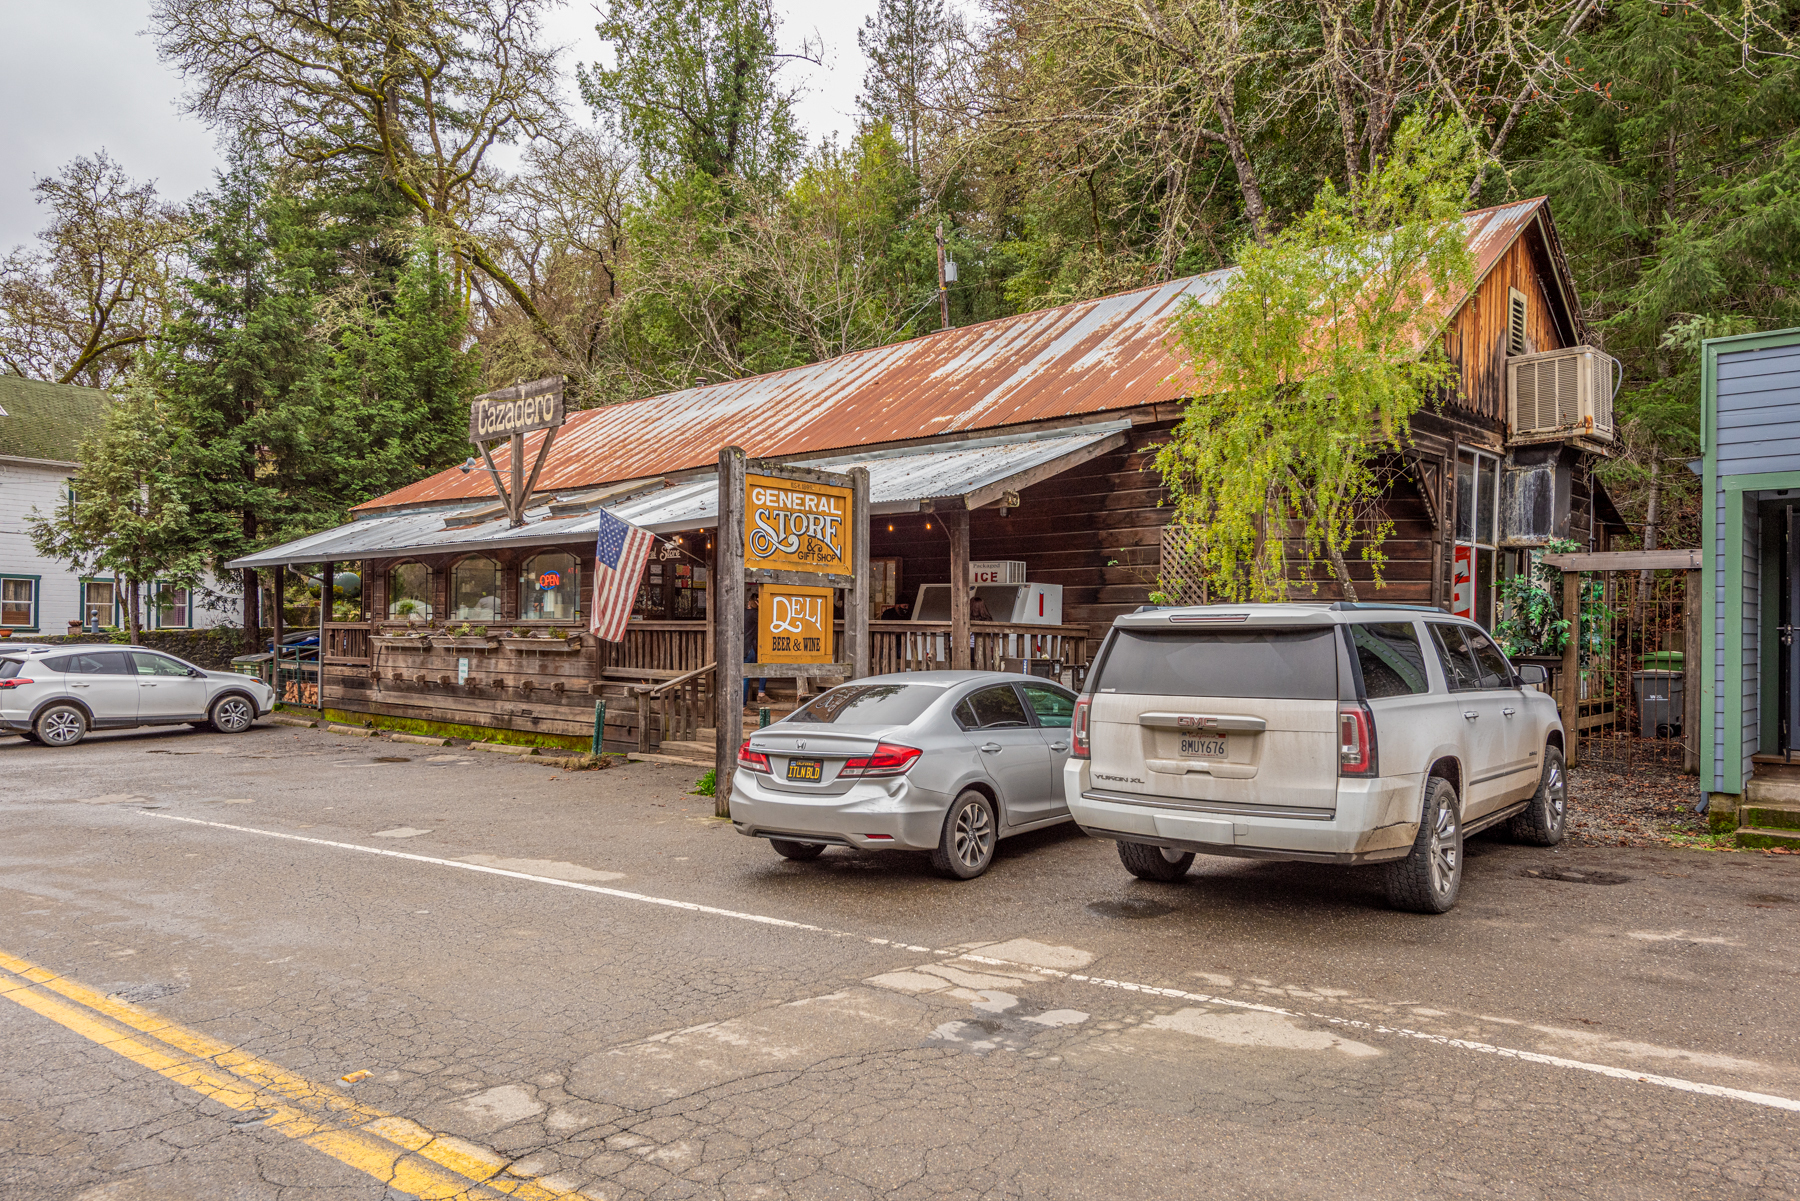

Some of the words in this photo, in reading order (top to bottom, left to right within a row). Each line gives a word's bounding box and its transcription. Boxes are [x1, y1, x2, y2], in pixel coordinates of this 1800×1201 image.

[478, 389, 553, 435] Cazadero
[752, 488, 842, 514] GENERAL
[749, 508, 842, 562] STORE
[807, 538, 822, 553] &
[660, 546, 681, 561] Store
[798, 551, 815, 562] GIFT
[817, 553, 836, 562] SHOP
[540, 575, 560, 586] OPEN
[974, 571, 998, 583] ICE
[770, 596, 822, 633] DELI
[772, 636, 791, 651] BEER
[793, 638, 802, 652] &
[803, 637, 821, 652] WINE
[1178, 716, 1218, 728] GMC
[1181, 740, 1225, 755] 8MUY676
[1094, 773, 1129, 783] YUKON
